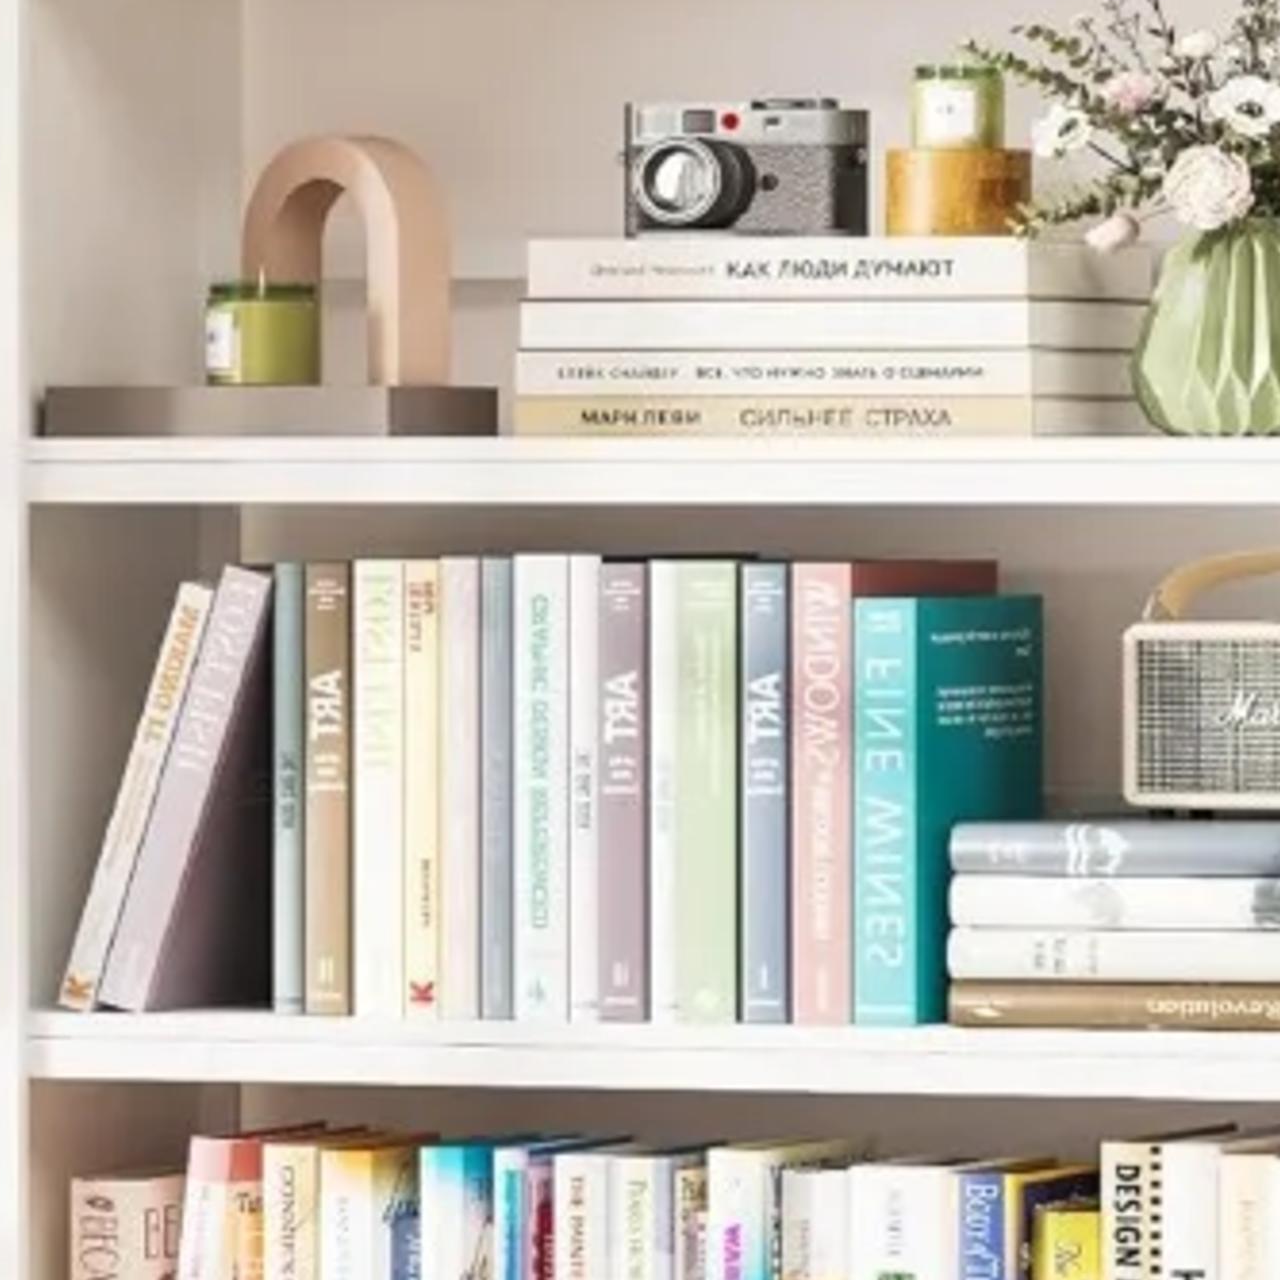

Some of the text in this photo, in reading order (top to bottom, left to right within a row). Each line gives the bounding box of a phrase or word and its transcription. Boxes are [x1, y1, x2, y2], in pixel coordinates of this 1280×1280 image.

[726, 260, 771, 278] КАК
[777, 260, 847, 280] ЛЮДИ
[852, 260, 955, 280] ДУМАЮТ
[738, 408, 852, 427] СИЛЬНЕЕ
[865, 408, 953, 427] СТРАХА
[1114, 1164, 1141, 1267] DESIGN
